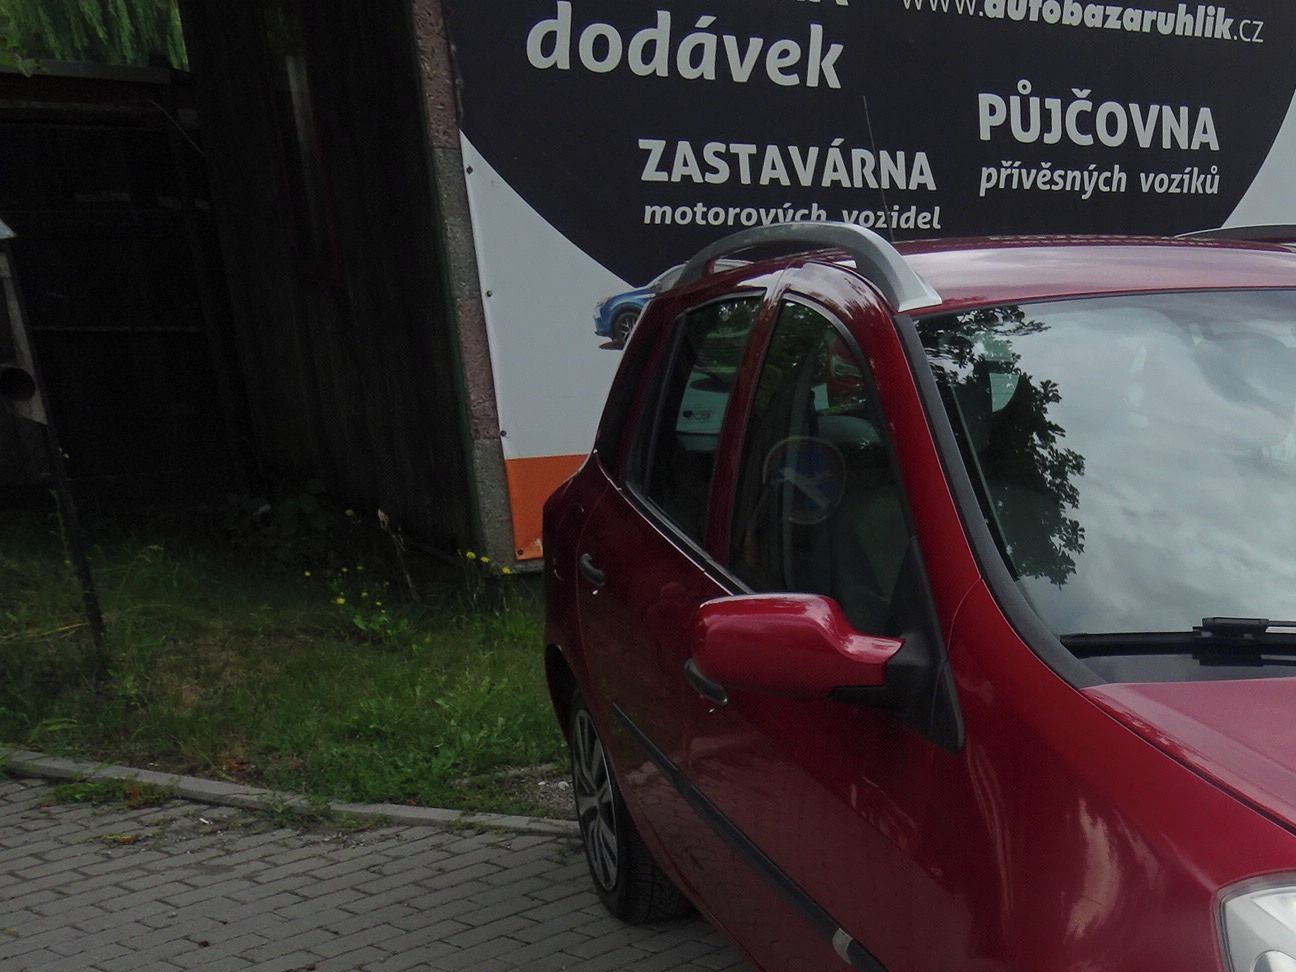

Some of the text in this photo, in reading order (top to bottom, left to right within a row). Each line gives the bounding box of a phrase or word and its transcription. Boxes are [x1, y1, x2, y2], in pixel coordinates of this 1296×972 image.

[526, 1, 845, 89] dodávek
[978, 79, 1220, 151] PŮJČOVNA
[638, 138, 937, 191] ZASTAVÁRNA
[979, 160, 1220, 200] přívěsných vozíků
[842, 205, 942, 230] vozidel
